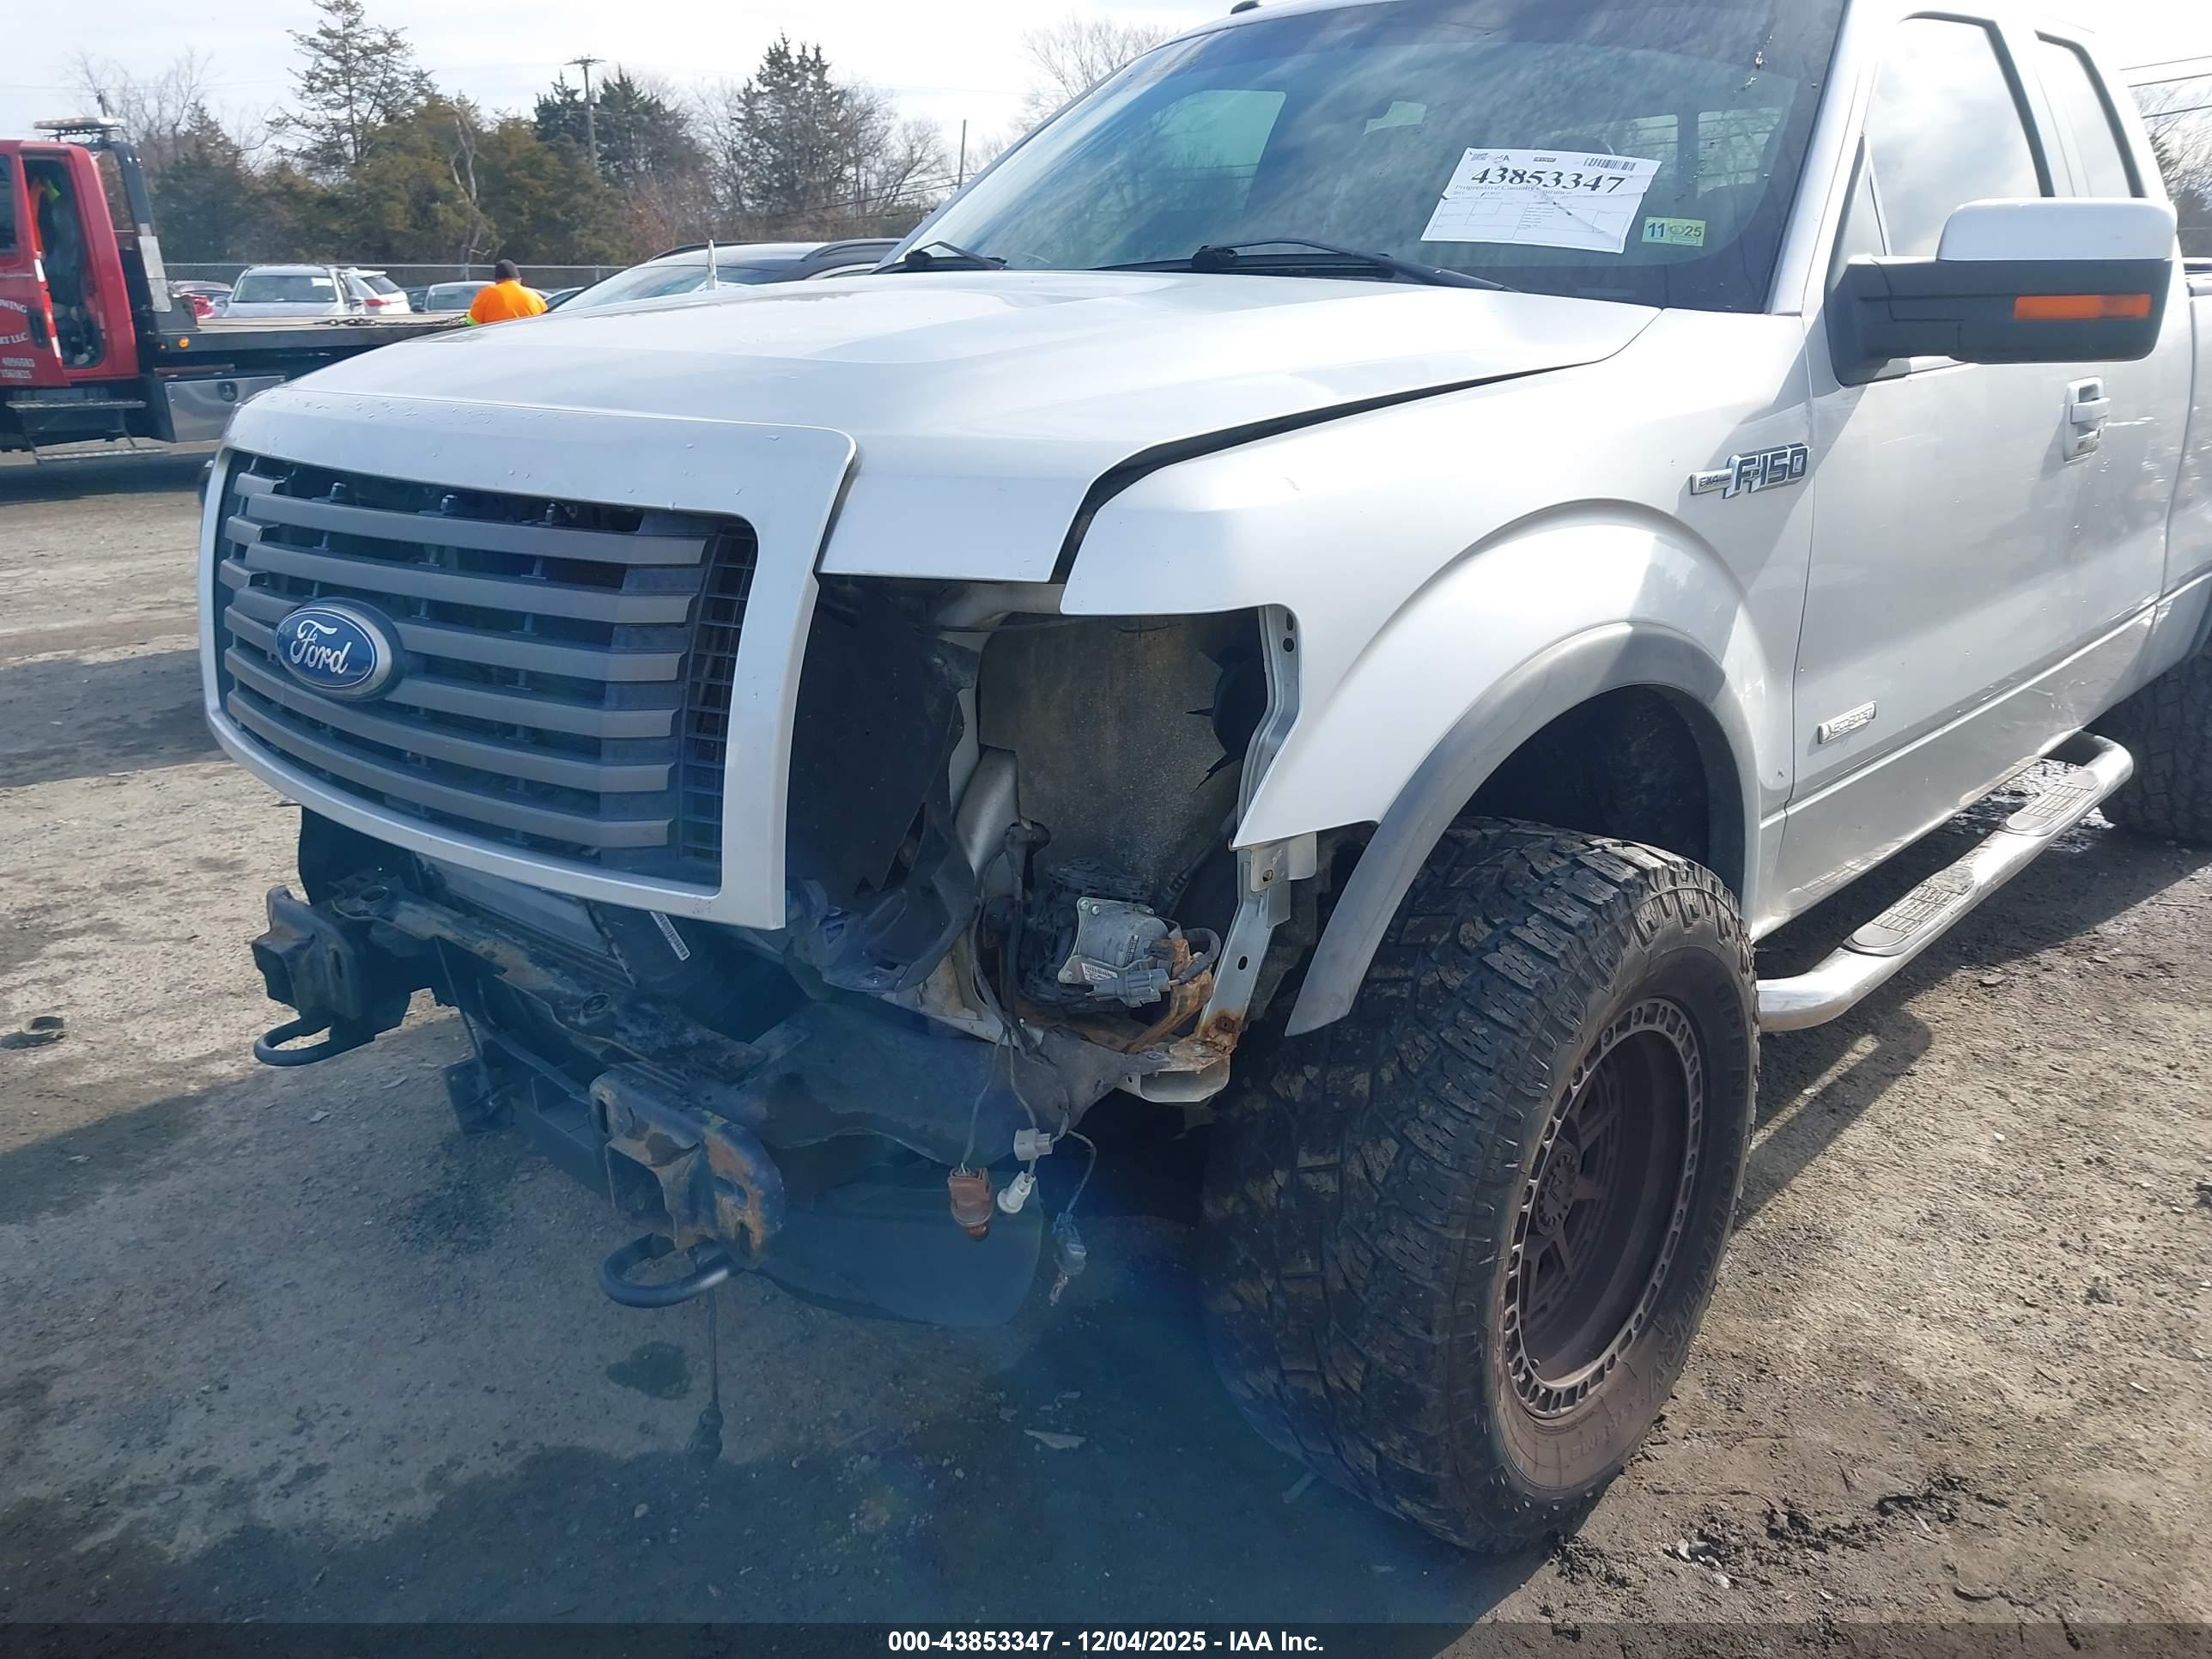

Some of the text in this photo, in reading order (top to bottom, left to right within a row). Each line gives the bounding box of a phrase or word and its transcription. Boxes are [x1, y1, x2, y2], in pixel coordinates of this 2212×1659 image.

[1471, 166, 1626, 194] 43853347
[1648, 222, 1703, 238] 11 25
[289, 618, 353, 675] Ford
